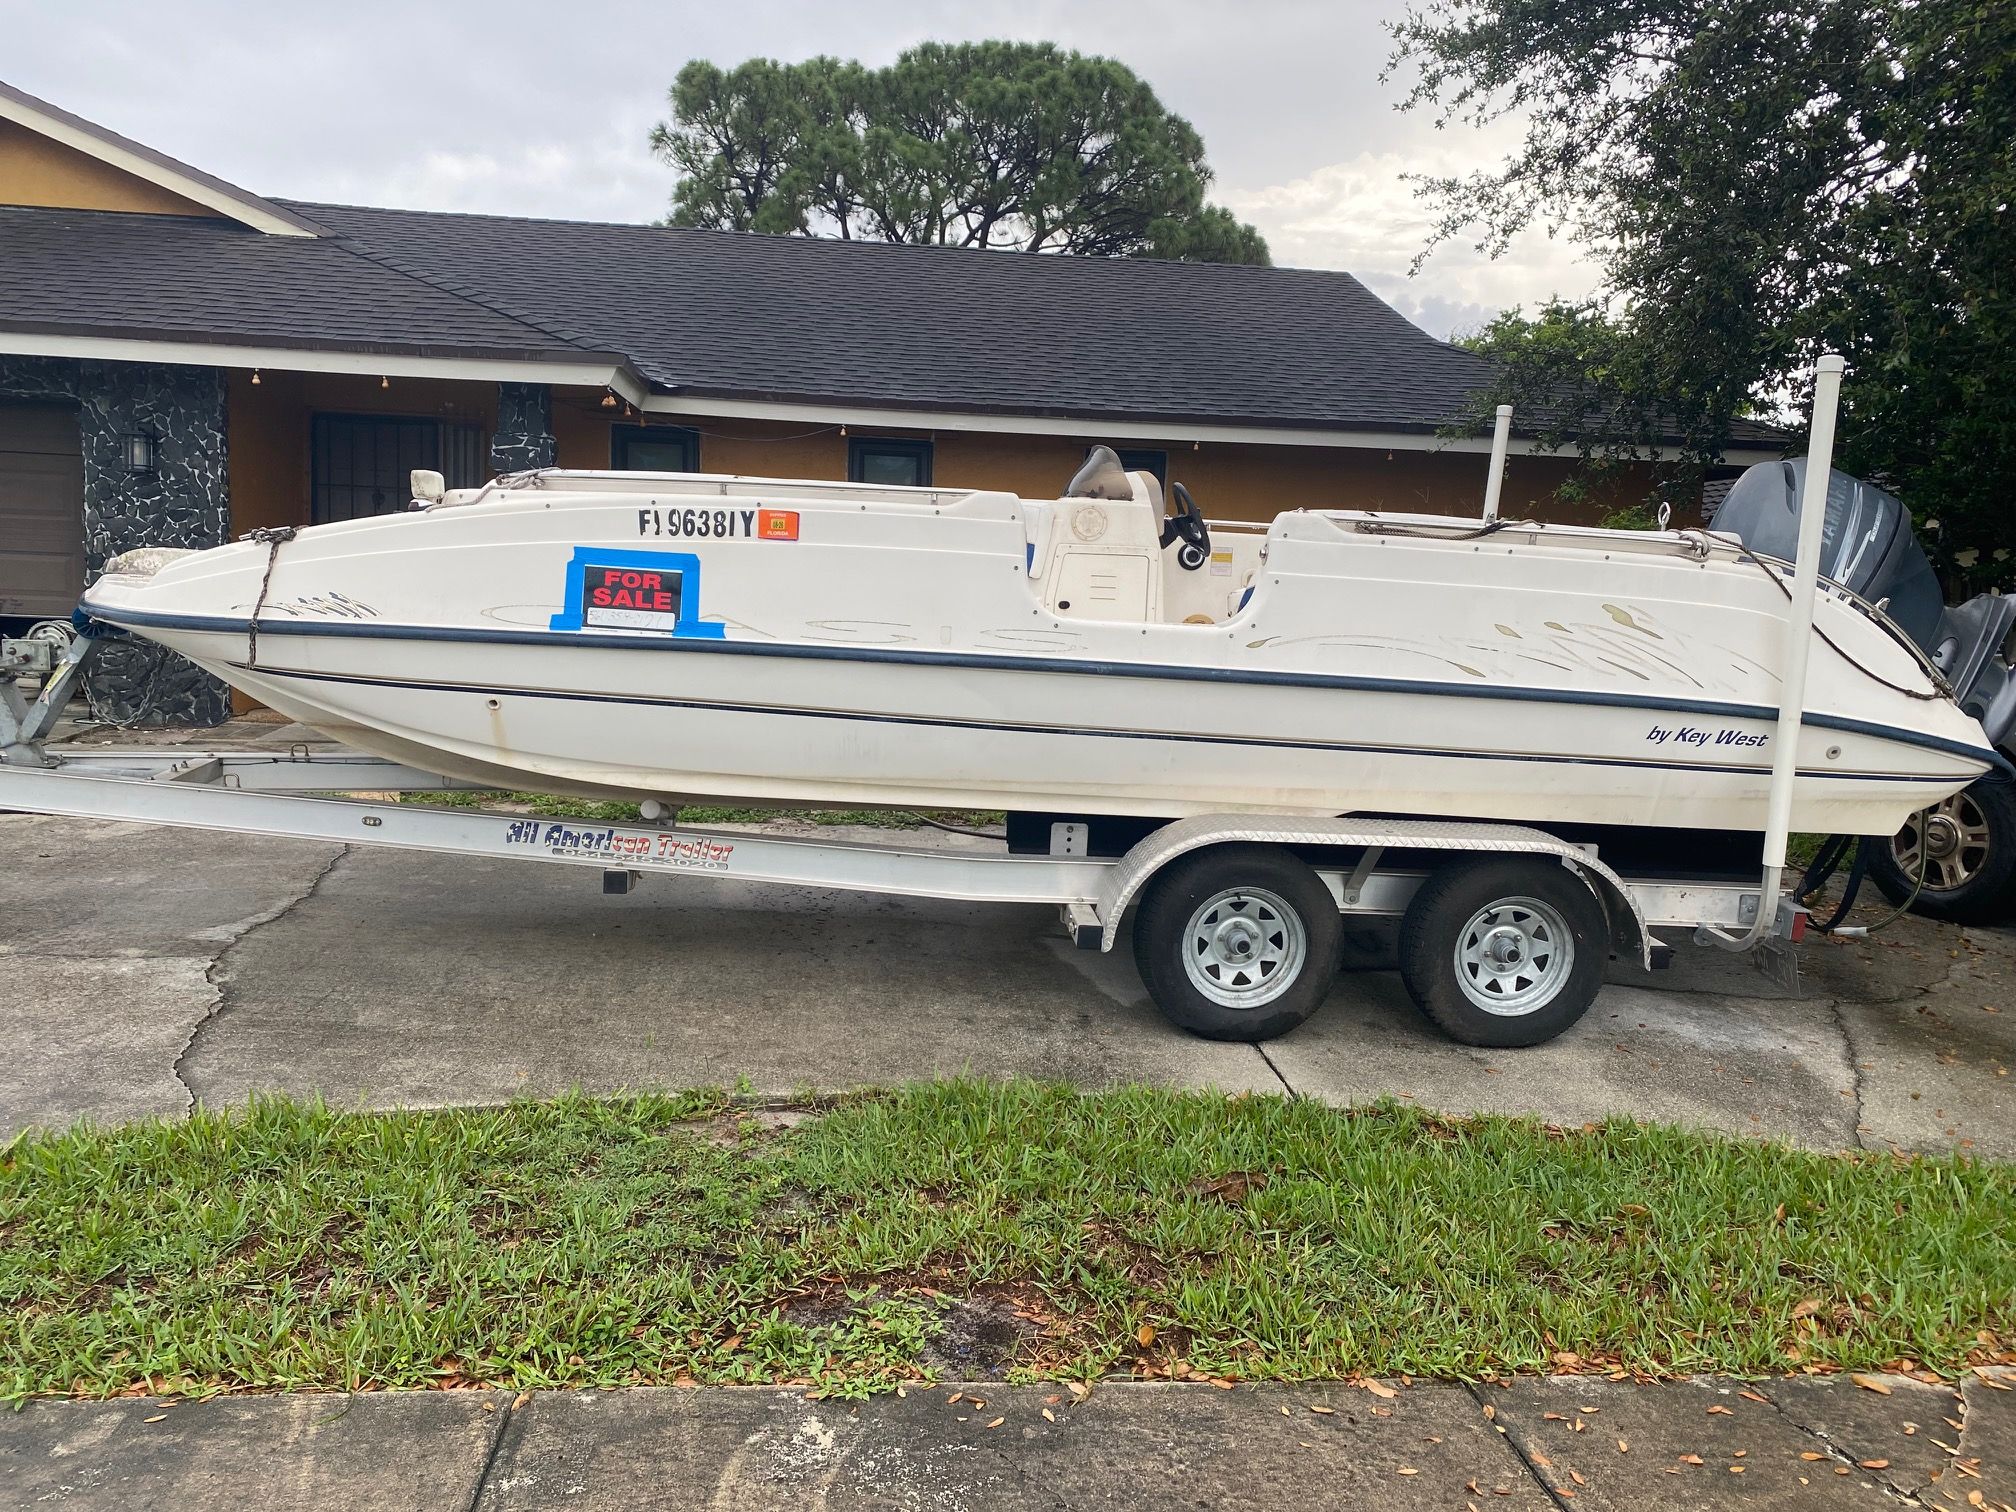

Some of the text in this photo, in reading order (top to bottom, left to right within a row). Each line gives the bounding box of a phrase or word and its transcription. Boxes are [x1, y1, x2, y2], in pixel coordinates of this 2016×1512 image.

[604, 570, 662, 590] FOR
[593, 589, 672, 610] SALE
[1646, 726, 1769, 747] by Key West
[506, 821, 734, 861] All American Trailer
